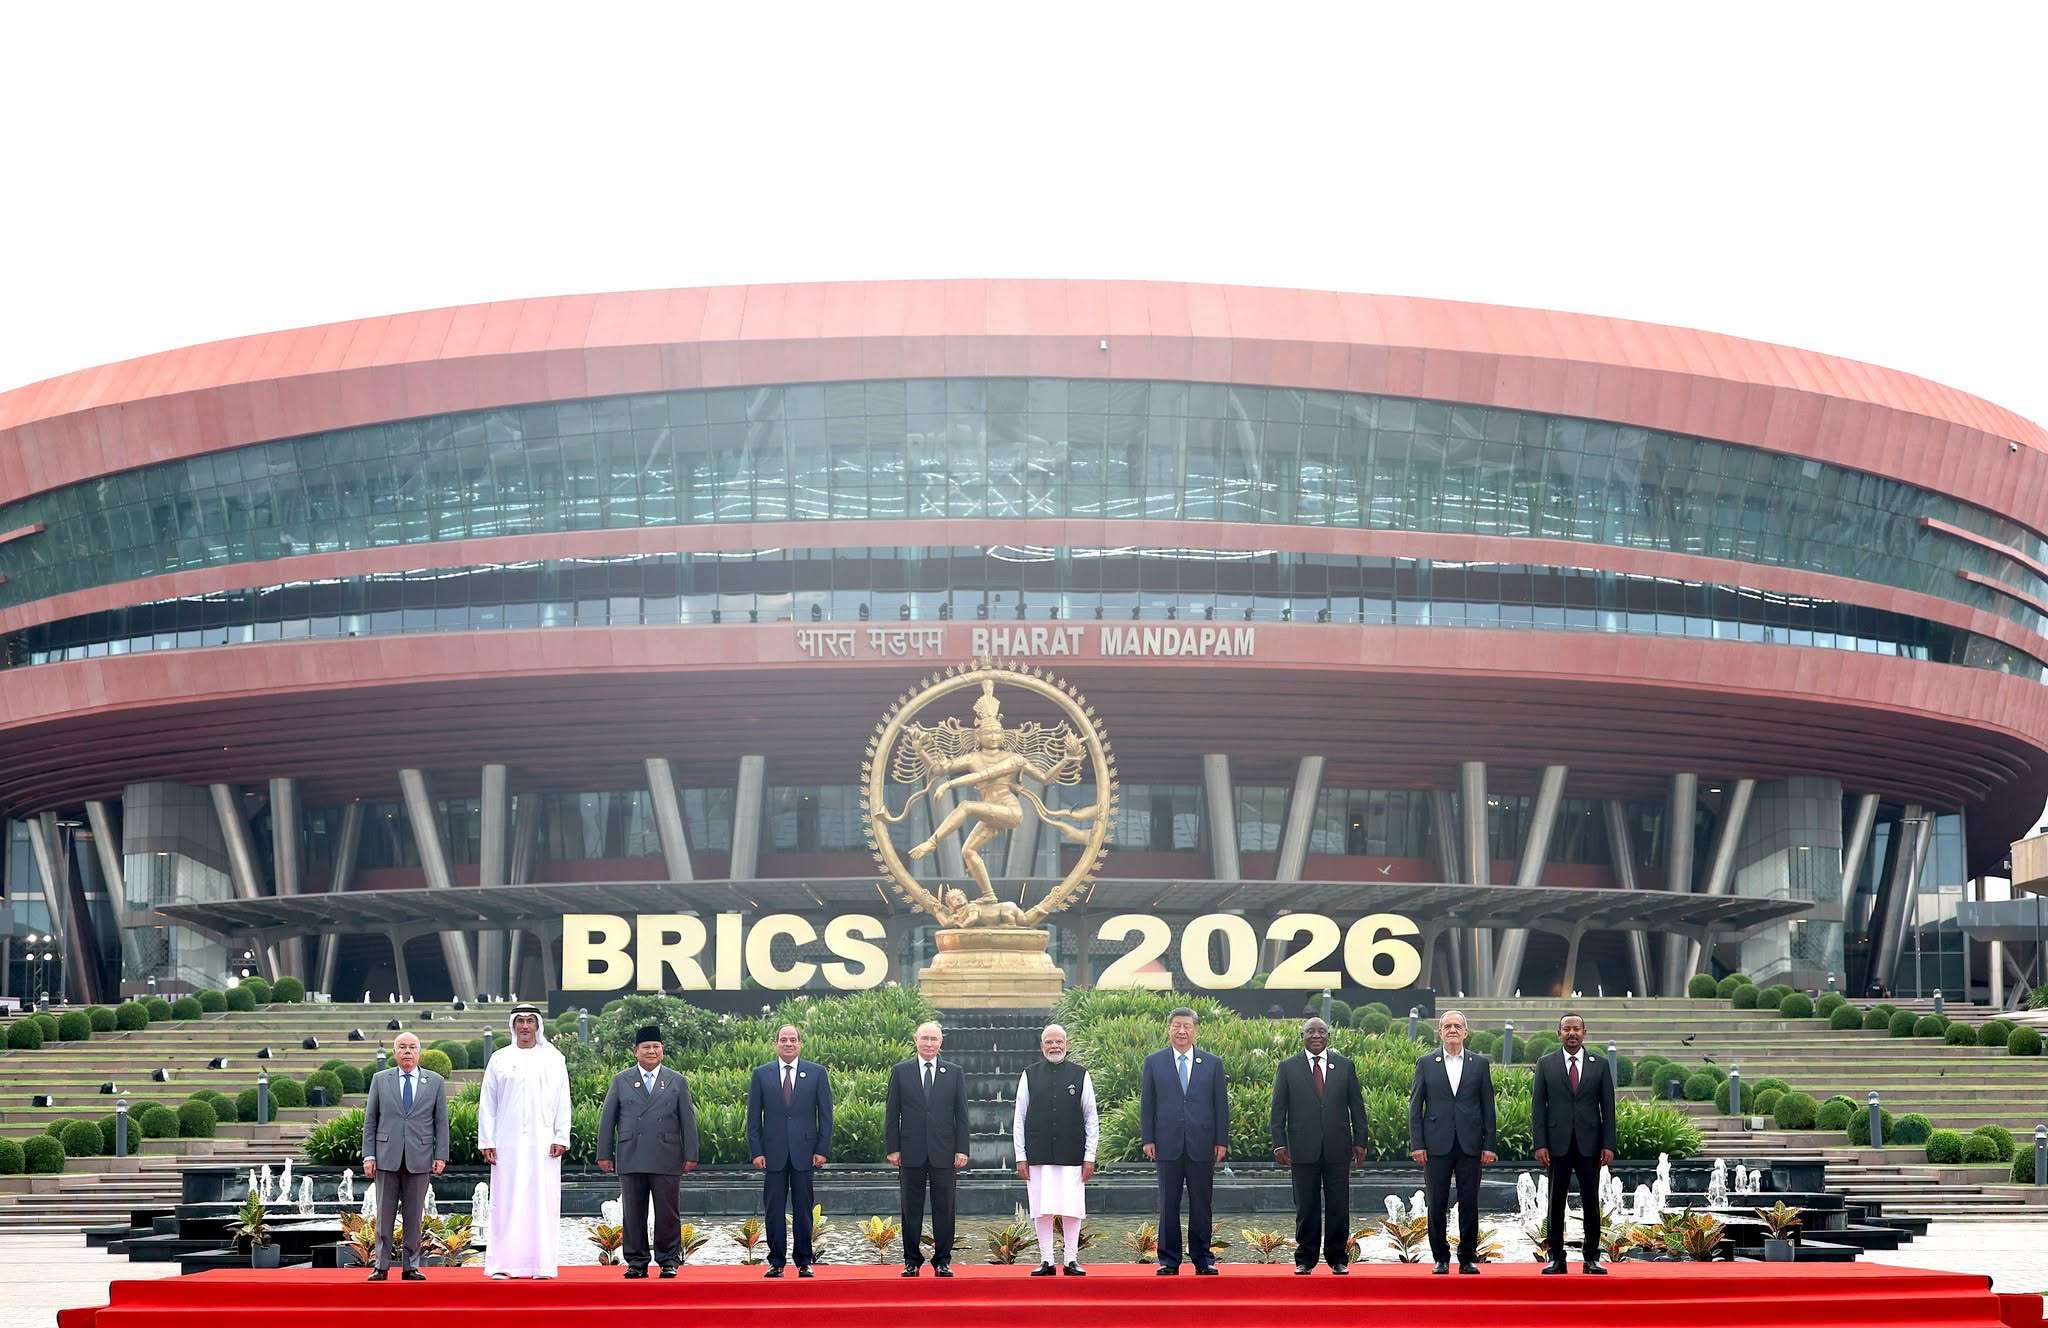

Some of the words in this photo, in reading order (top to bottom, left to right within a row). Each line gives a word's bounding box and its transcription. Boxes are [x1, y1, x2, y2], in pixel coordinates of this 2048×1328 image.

[797, 628, 856, 657] भारत
[971, 627, 1084, 656] BHARAT
[1101, 627, 1255, 656] MANDAPAM
[562, 913, 889, 991] BRICS
[1096, 913, 1422, 990] 2026
